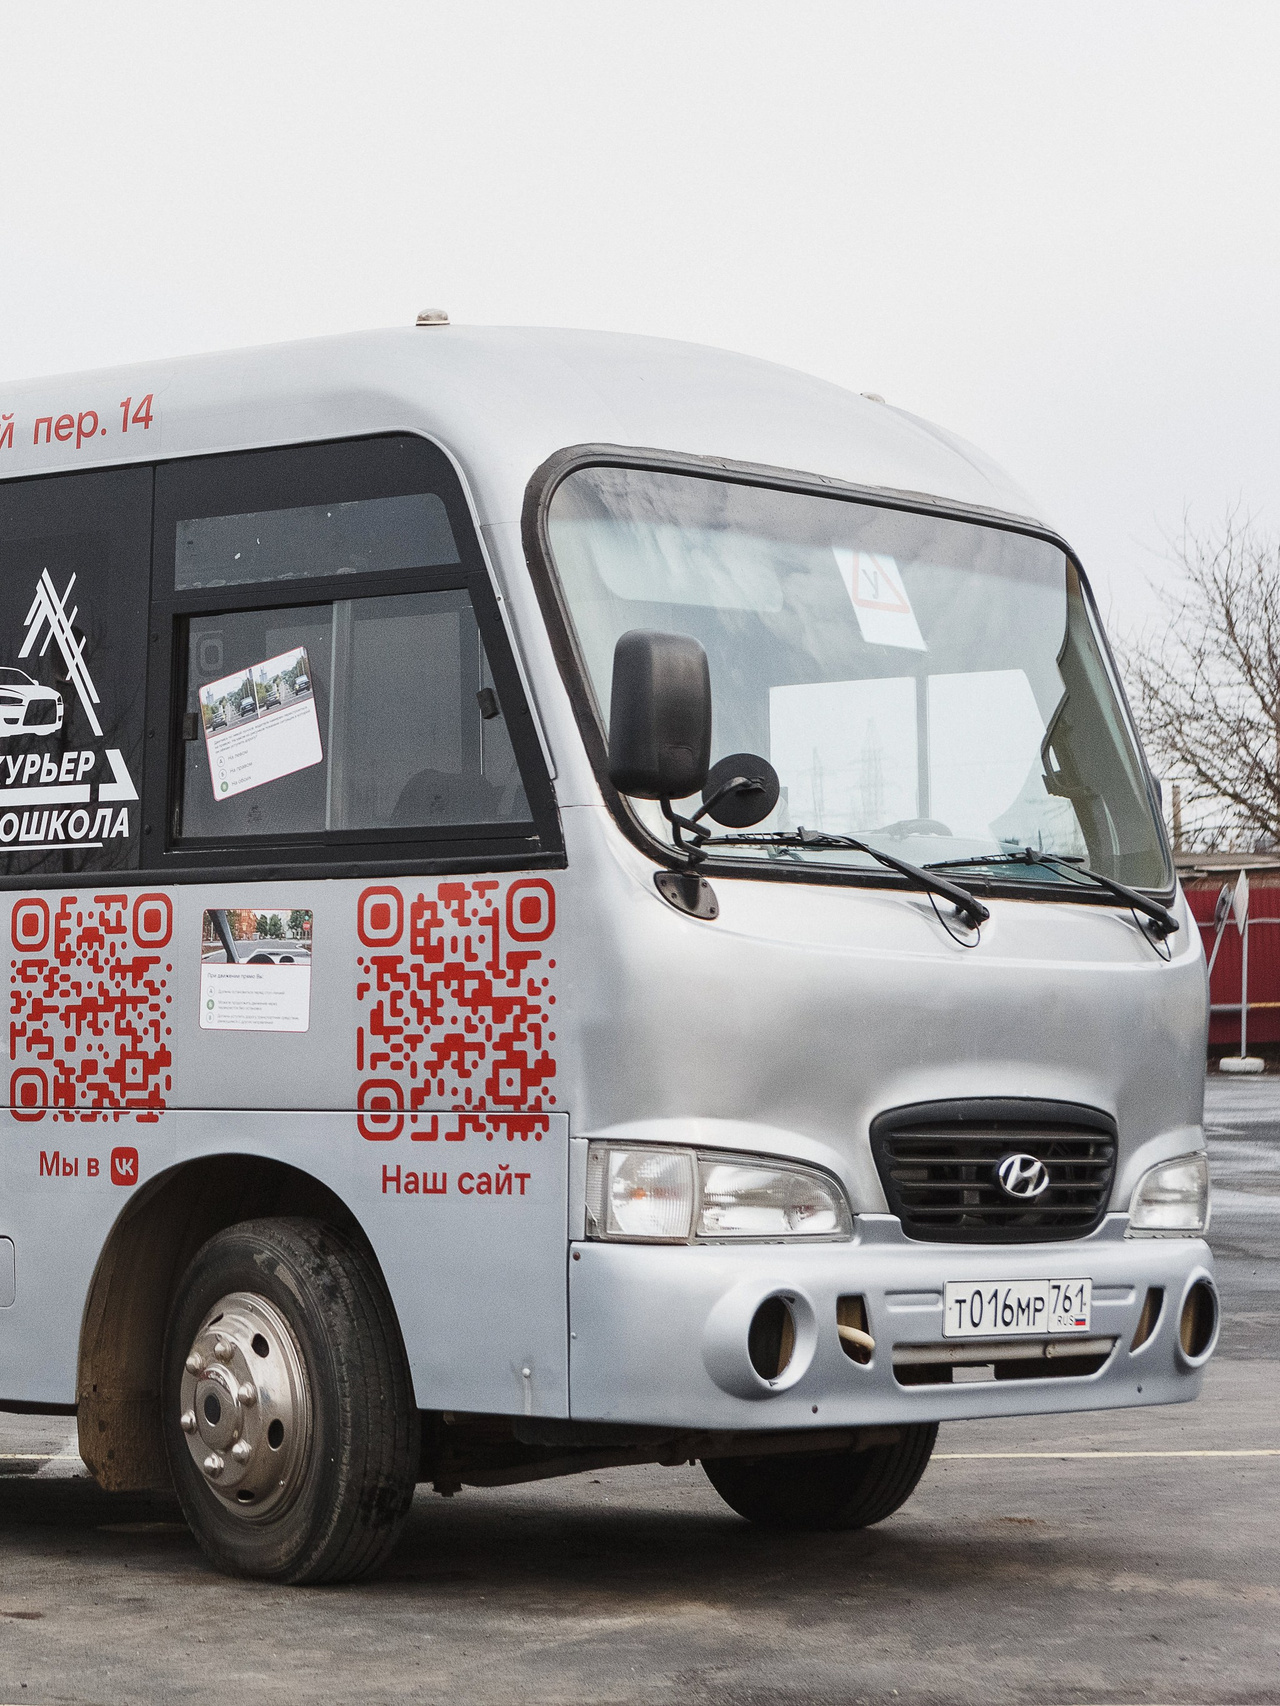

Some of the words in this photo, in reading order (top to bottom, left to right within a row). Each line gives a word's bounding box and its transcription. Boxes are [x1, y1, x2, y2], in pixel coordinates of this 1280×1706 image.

[34, 411, 107, 449] пер.
[121, 395, 152, 432] 14
[40, 1151, 78, 1176] Мы
[87, 1158, 99, 1176] в
[382, 1165, 447, 1194] Наш
[458, 1164, 530, 1195] сайт
[1051, 1284, 1084, 1314] 761
[1057, 1315, 1074, 1326] RUS
